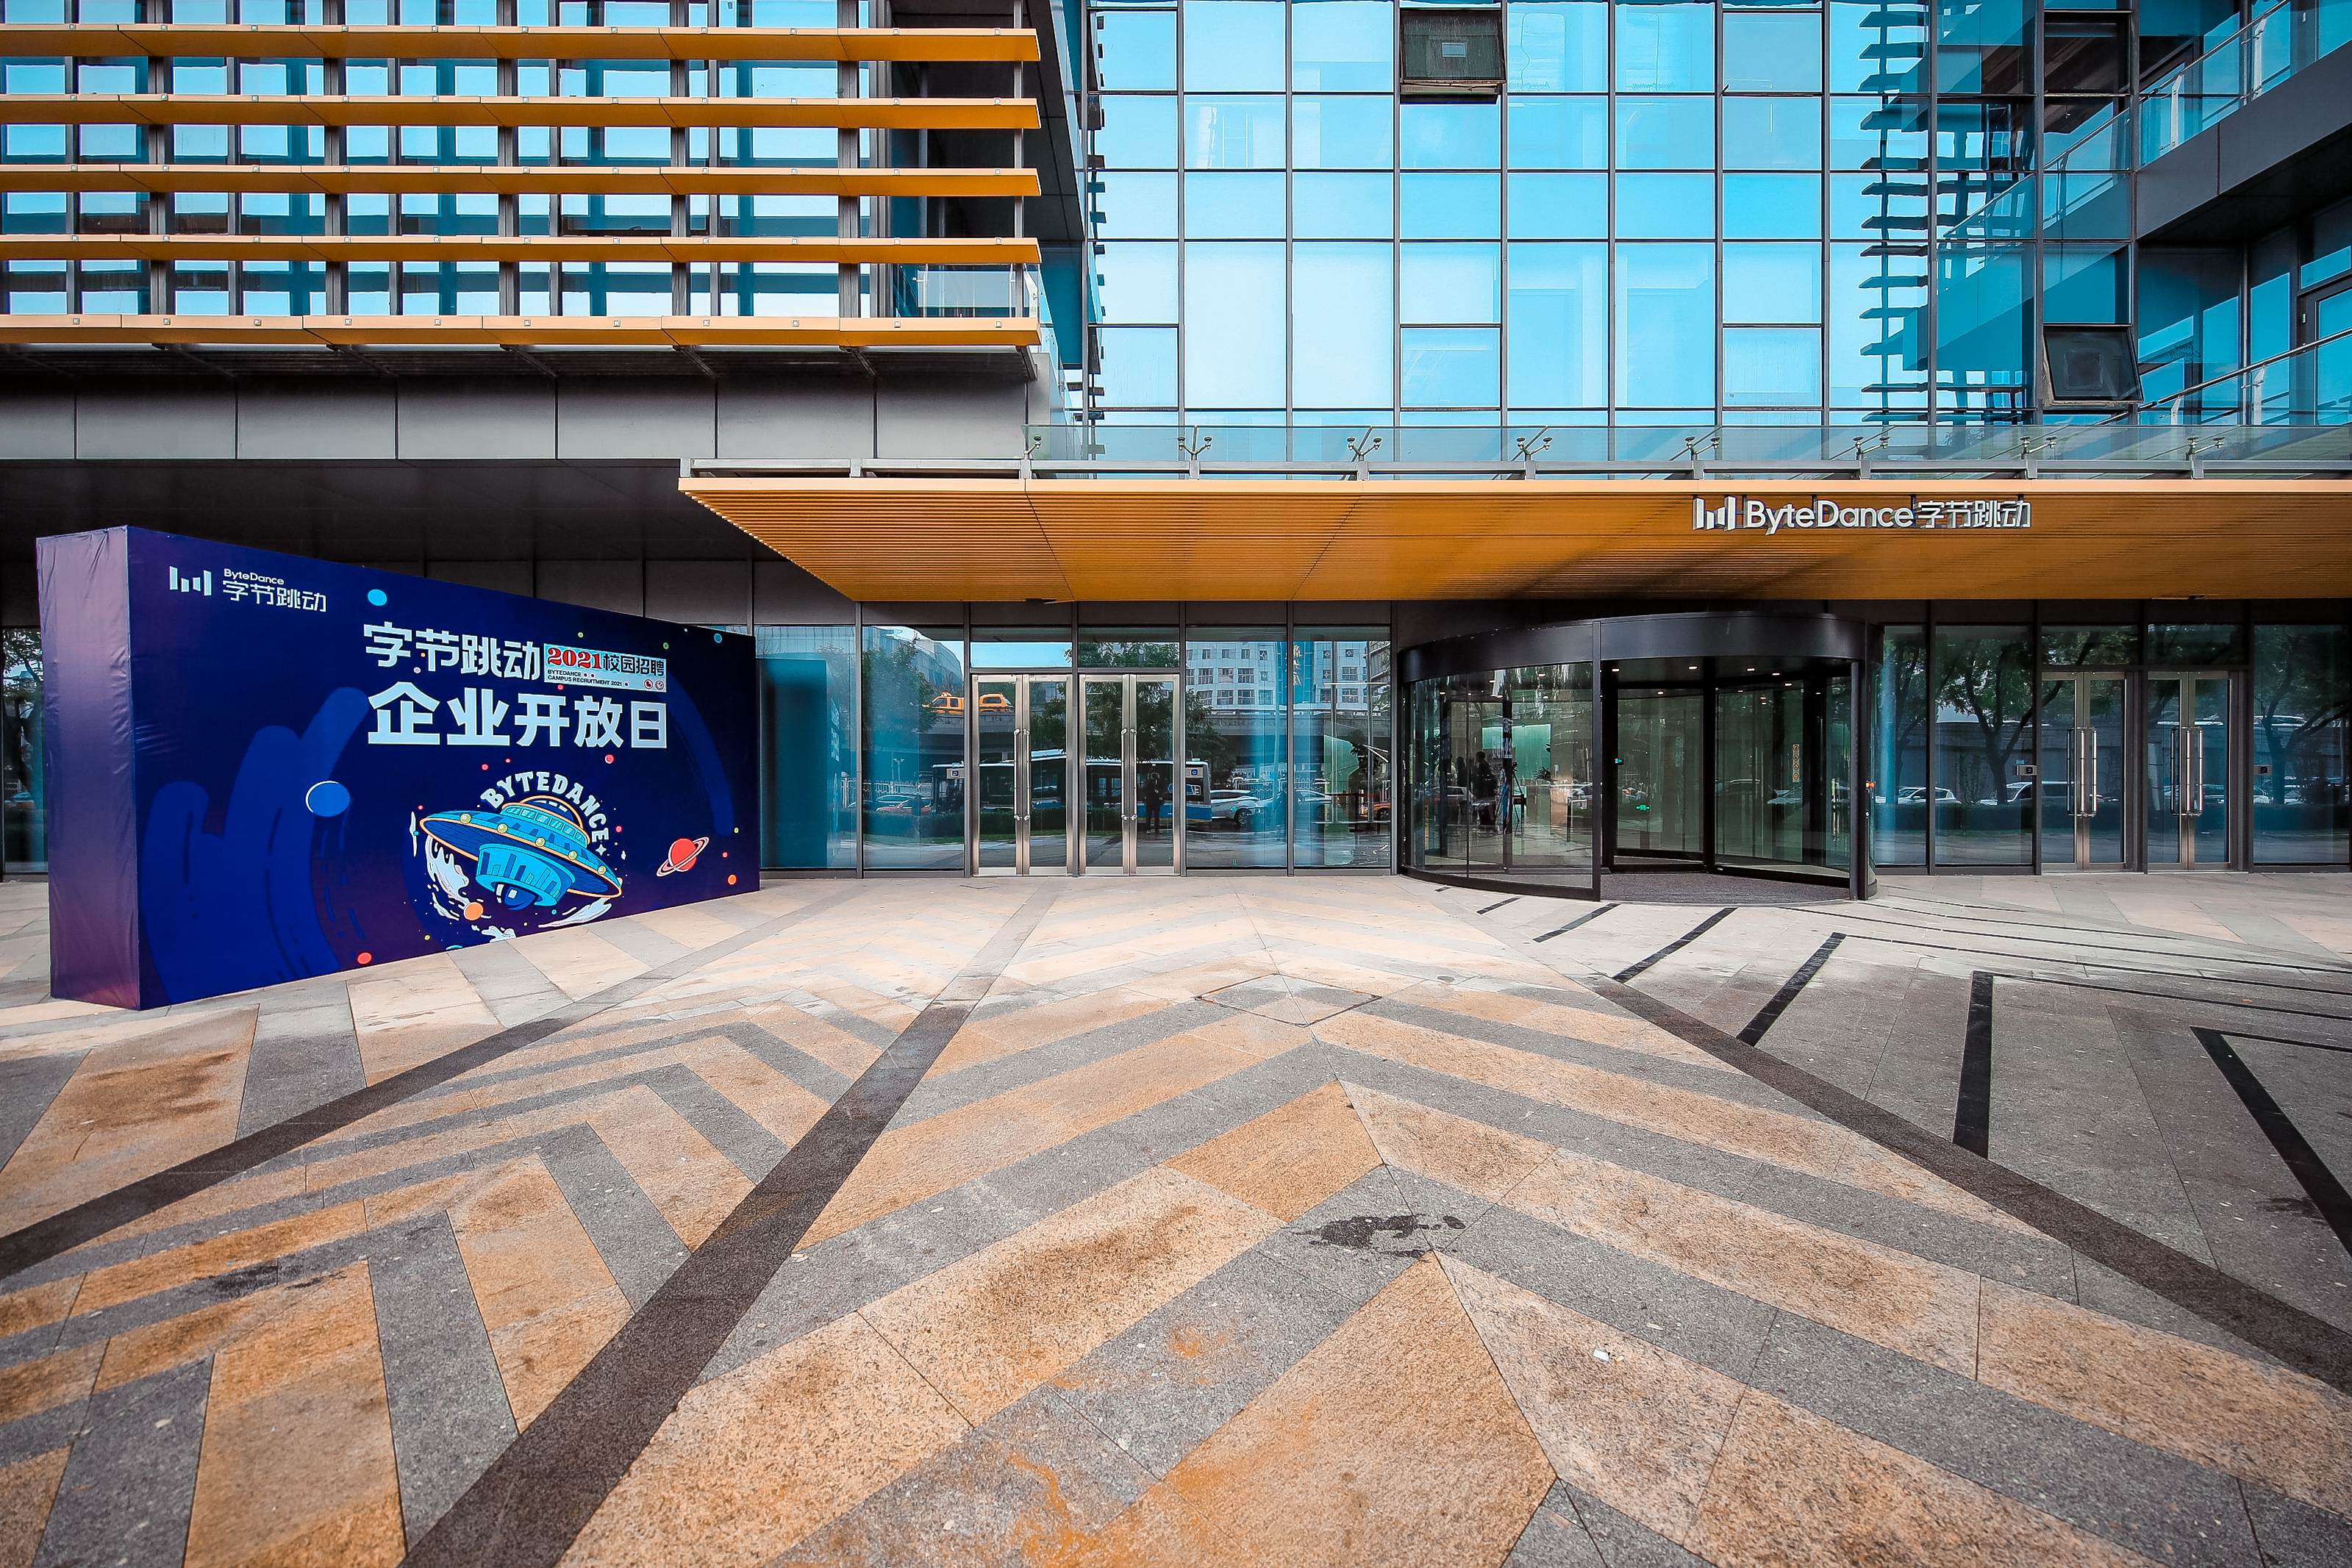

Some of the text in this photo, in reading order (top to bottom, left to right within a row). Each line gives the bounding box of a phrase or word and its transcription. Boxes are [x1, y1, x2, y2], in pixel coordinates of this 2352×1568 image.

[1745, 500, 2031, 536] ByteDance 字节跳动
[224, 568, 285, 585] ByteDance
[222, 580, 327, 612] 字节跳动
[363, 621, 540, 681] 字节跳动
[547, 669, 582, 677] BYTEDANCE
[573, 676, 610, 685] RECRUITMENT
[368, 681, 667, 749] 企业开放日
[480, 770, 610, 842] BYTEDANCE
